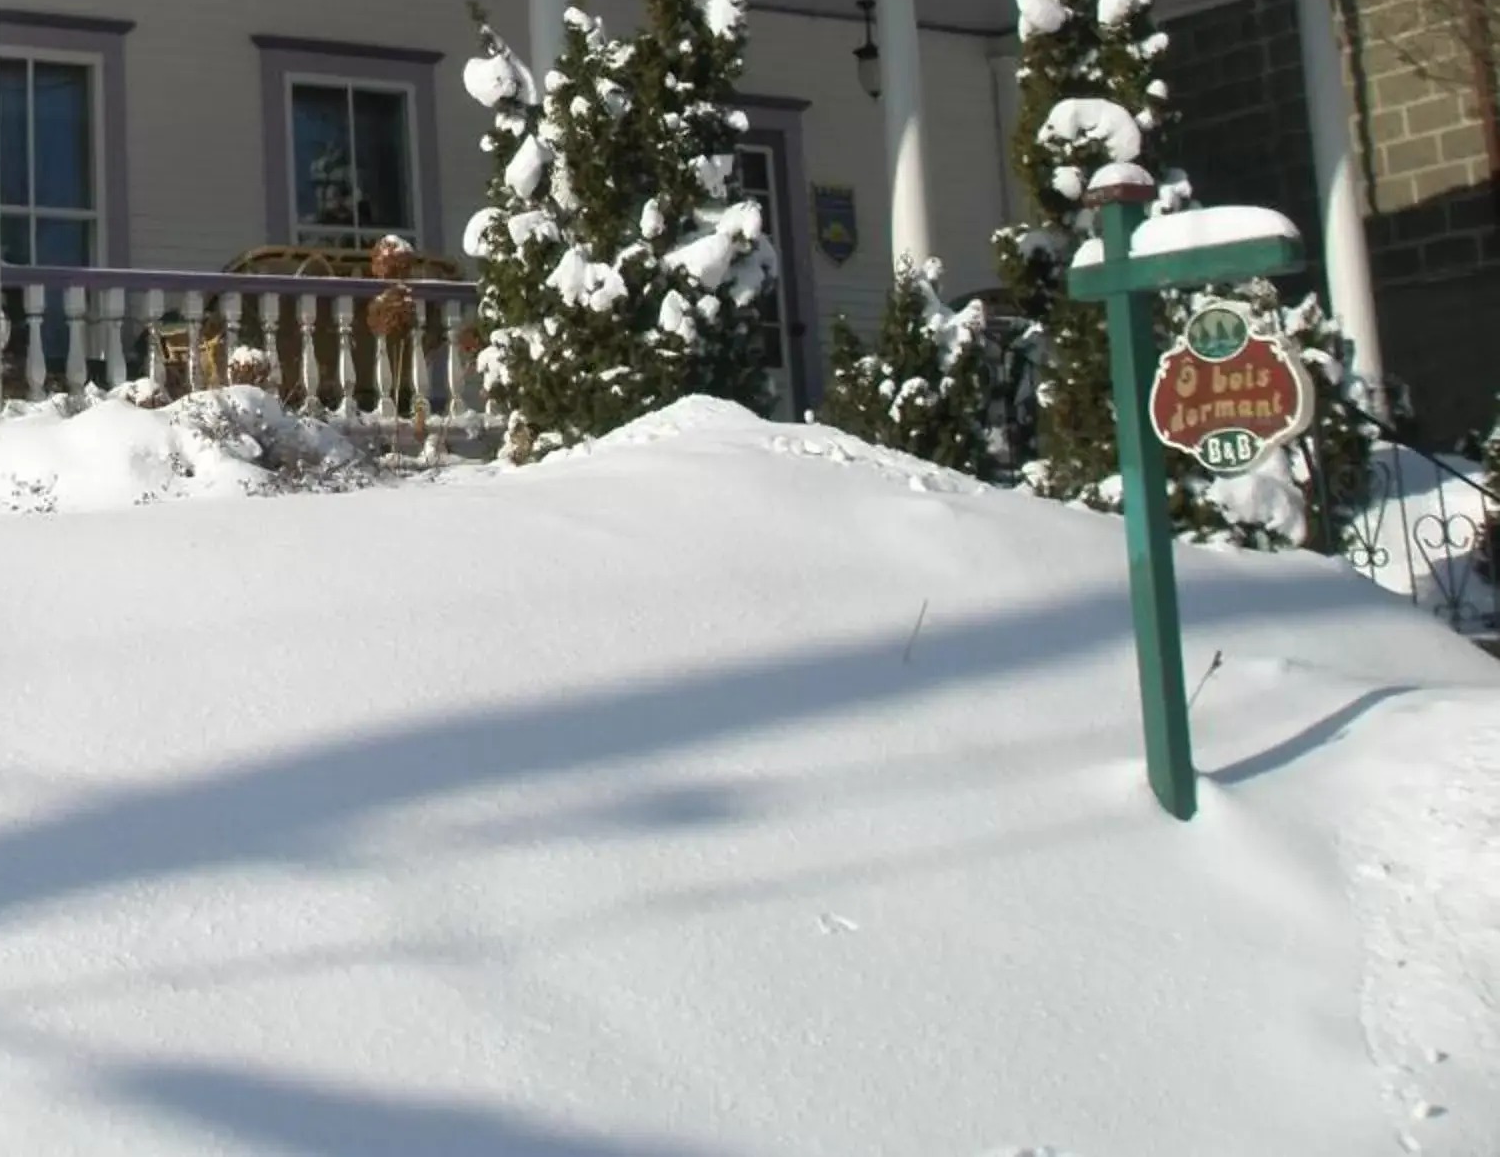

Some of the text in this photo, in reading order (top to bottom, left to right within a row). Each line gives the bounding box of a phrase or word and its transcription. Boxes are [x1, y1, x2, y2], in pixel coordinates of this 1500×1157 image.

[1176, 357, 1271, 398] Ô bois
[1169, 391, 1284, 432] dormant
[1207, 434, 1251, 465] B&B
